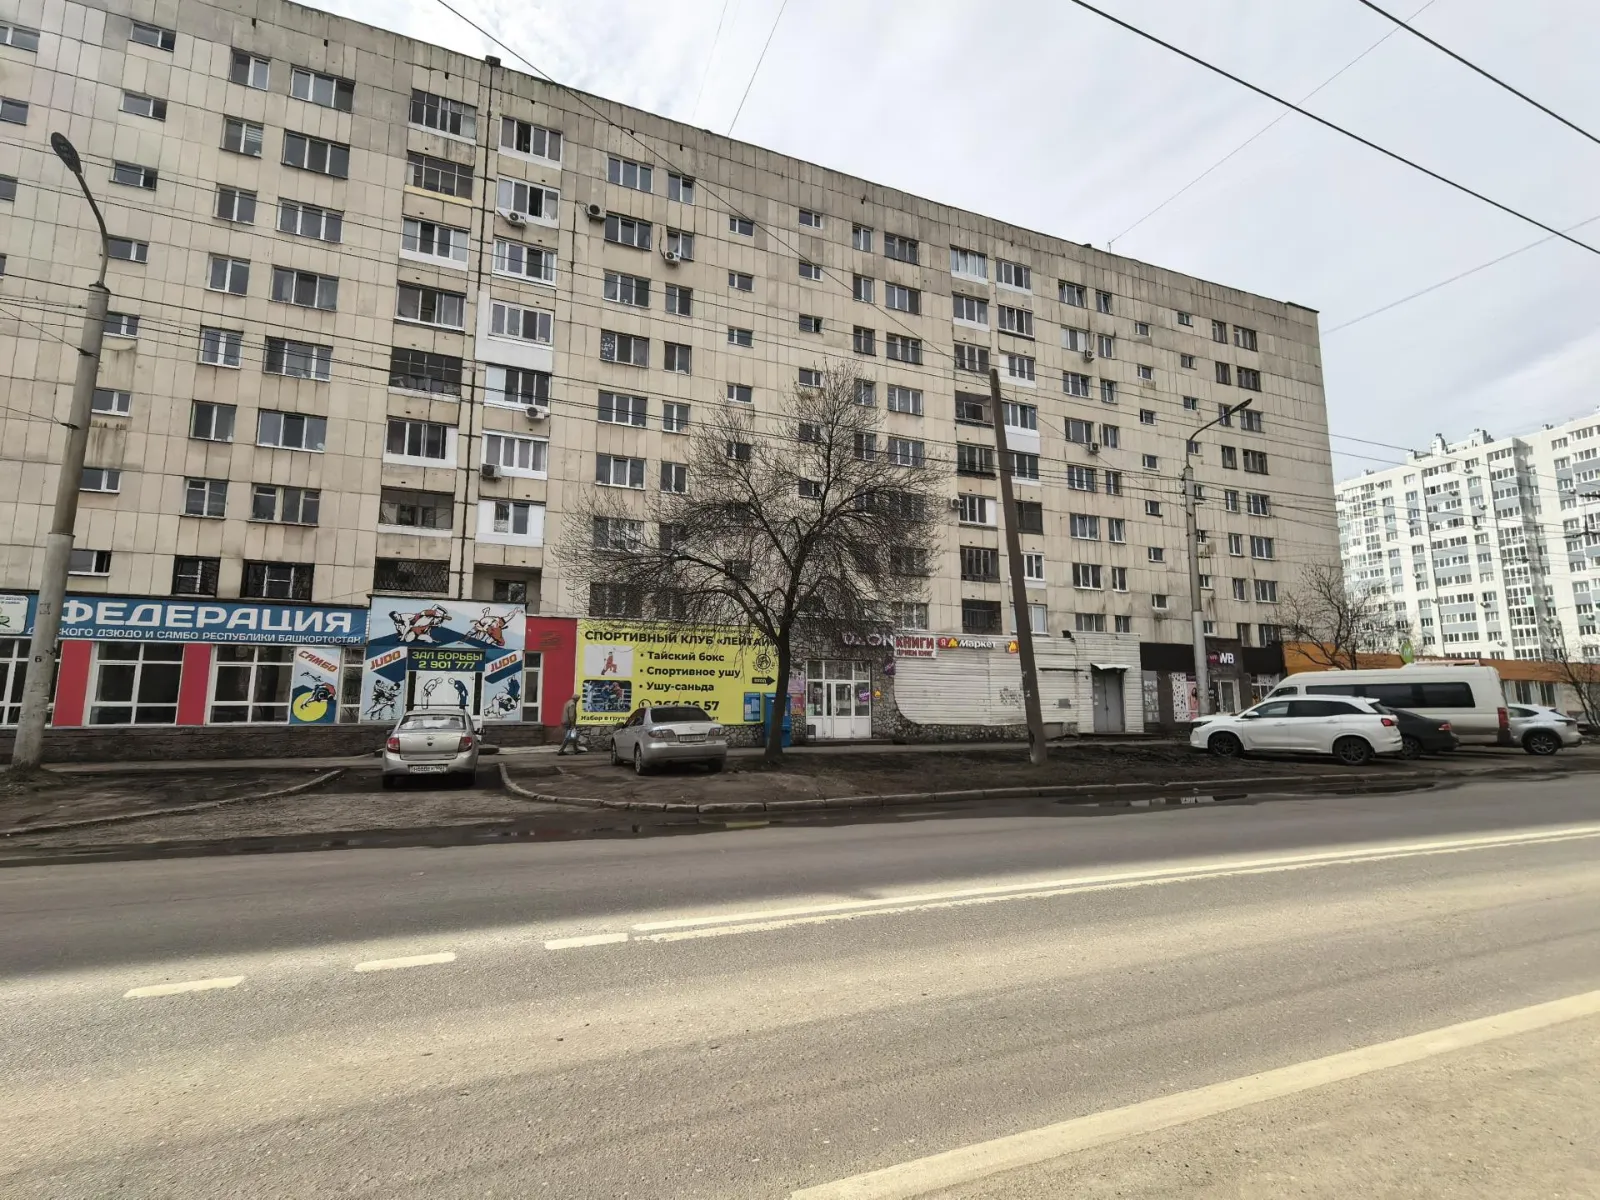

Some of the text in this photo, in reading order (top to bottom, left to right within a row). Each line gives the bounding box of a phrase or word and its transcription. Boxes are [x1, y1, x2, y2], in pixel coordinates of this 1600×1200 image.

[62, 599, 352, 633] ФЕДЕРАЦИЯ
[97, 628, 142, 639] ДЗЮДО
[145, 630, 154, 639] И
[157, 631, 198, 640] САМБО
[202, 631, 275, 643] РЕСПУБЛИКИ
[278, 634, 361, 644] БАШКОРТОСТАН
[584, 630, 677, 644] СПОРТИВНЫЙ
[681, 635, 714, 645] КЛУБ
[896, 636, 934, 649] КНИГИ
[959, 639, 997, 649] Маркет
[298, 650, 339, 674] САМБО
[370, 650, 401, 670] JUDO
[411, 651, 483, 661] ЗАЛ БОРЬБЫ
[490, 653, 518, 672] JUDO
[648, 651, 725, 662] Тайский бокс
[1219, 652, 1234, 664] WB
[418, 661, 476, 670] 2 901 777
[646, 666, 741, 680] Спортивное ушу
[646, 682, 715, 693] Ушу-саньда
[704, 700, 720, 711] 57
